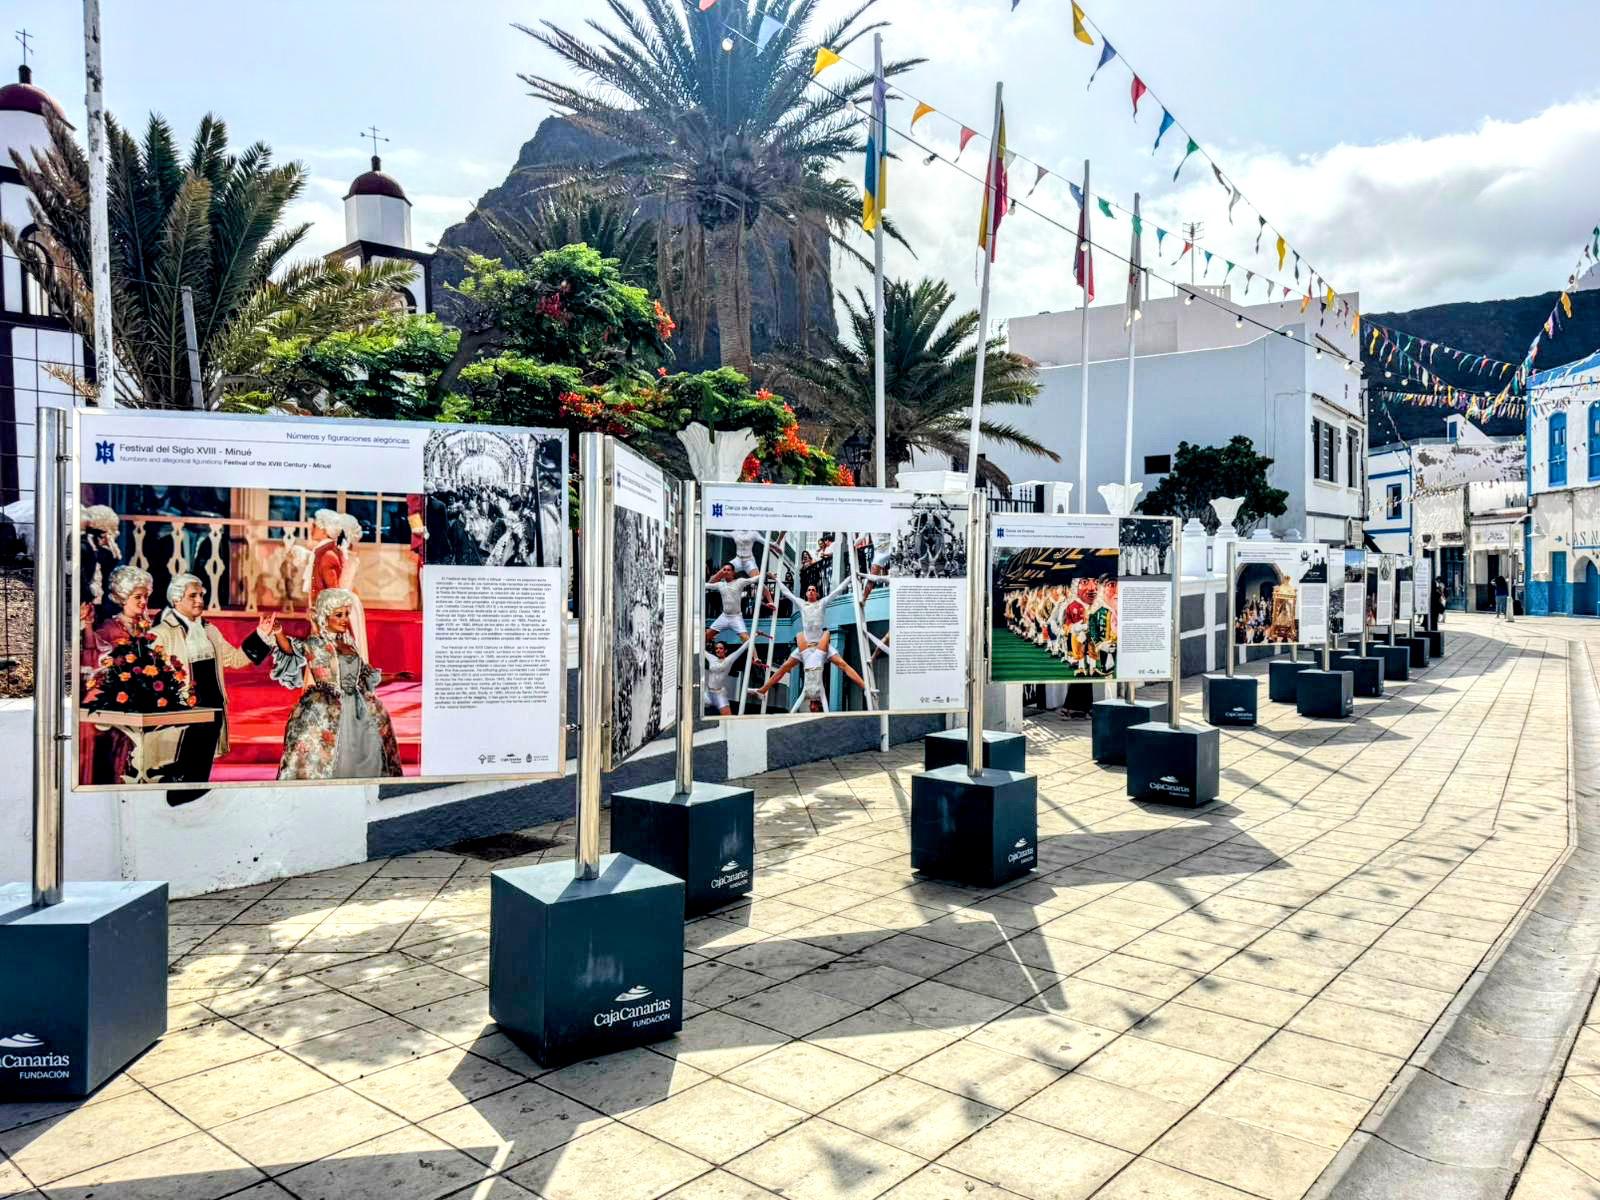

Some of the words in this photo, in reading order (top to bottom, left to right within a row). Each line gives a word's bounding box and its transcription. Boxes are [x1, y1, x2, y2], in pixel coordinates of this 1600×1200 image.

[286, 431, 320, 440] Números
[327, 433, 371, 443] figuraciones
[120, 443, 153, 452] Festival
[156, 445, 169, 453] del
[172, 445, 194, 455] Siglo
[196, 446, 216, 455] XVIII
[225, 447, 252, 456] Minué
[283, 461, 307, 469] Century
[593, 999, 671, 1027] CajaCanarias
[632, 1012, 671, 1028] FUNDACIÓN
[0, 1052, 70, 1069] Canarias
[19, 1069, 70, 1080] FUNDACIÓN
